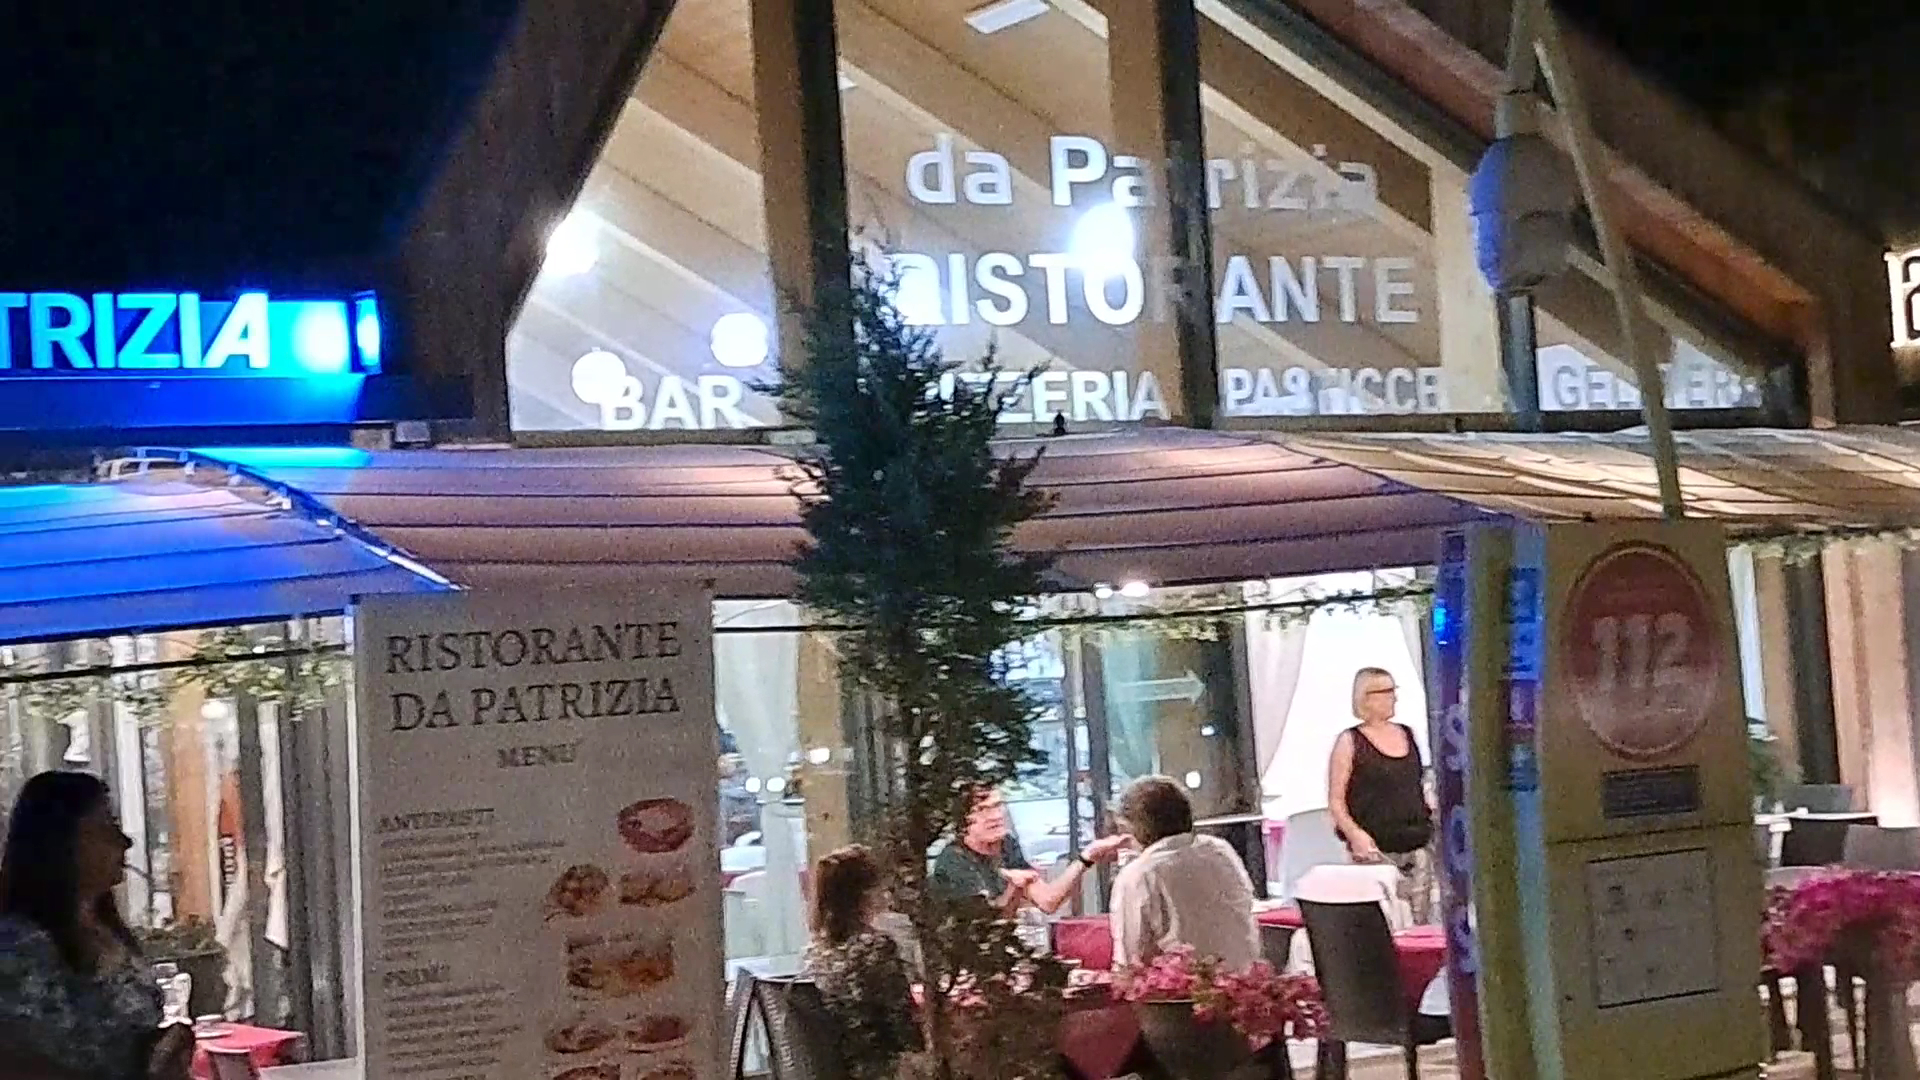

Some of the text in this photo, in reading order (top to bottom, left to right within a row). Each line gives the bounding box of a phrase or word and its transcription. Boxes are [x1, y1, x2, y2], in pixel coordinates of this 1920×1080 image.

[906, 134, 1378, 209] da Parizia
[893, 252, 1420, 325] RISTOANTE
[601, 374, 749, 430] BAR
[385, 621, 682, 674] RISTORANTE
[1593, 611, 1693, 689] 112
[391, 677, 682, 732] DA PATRIZIA
